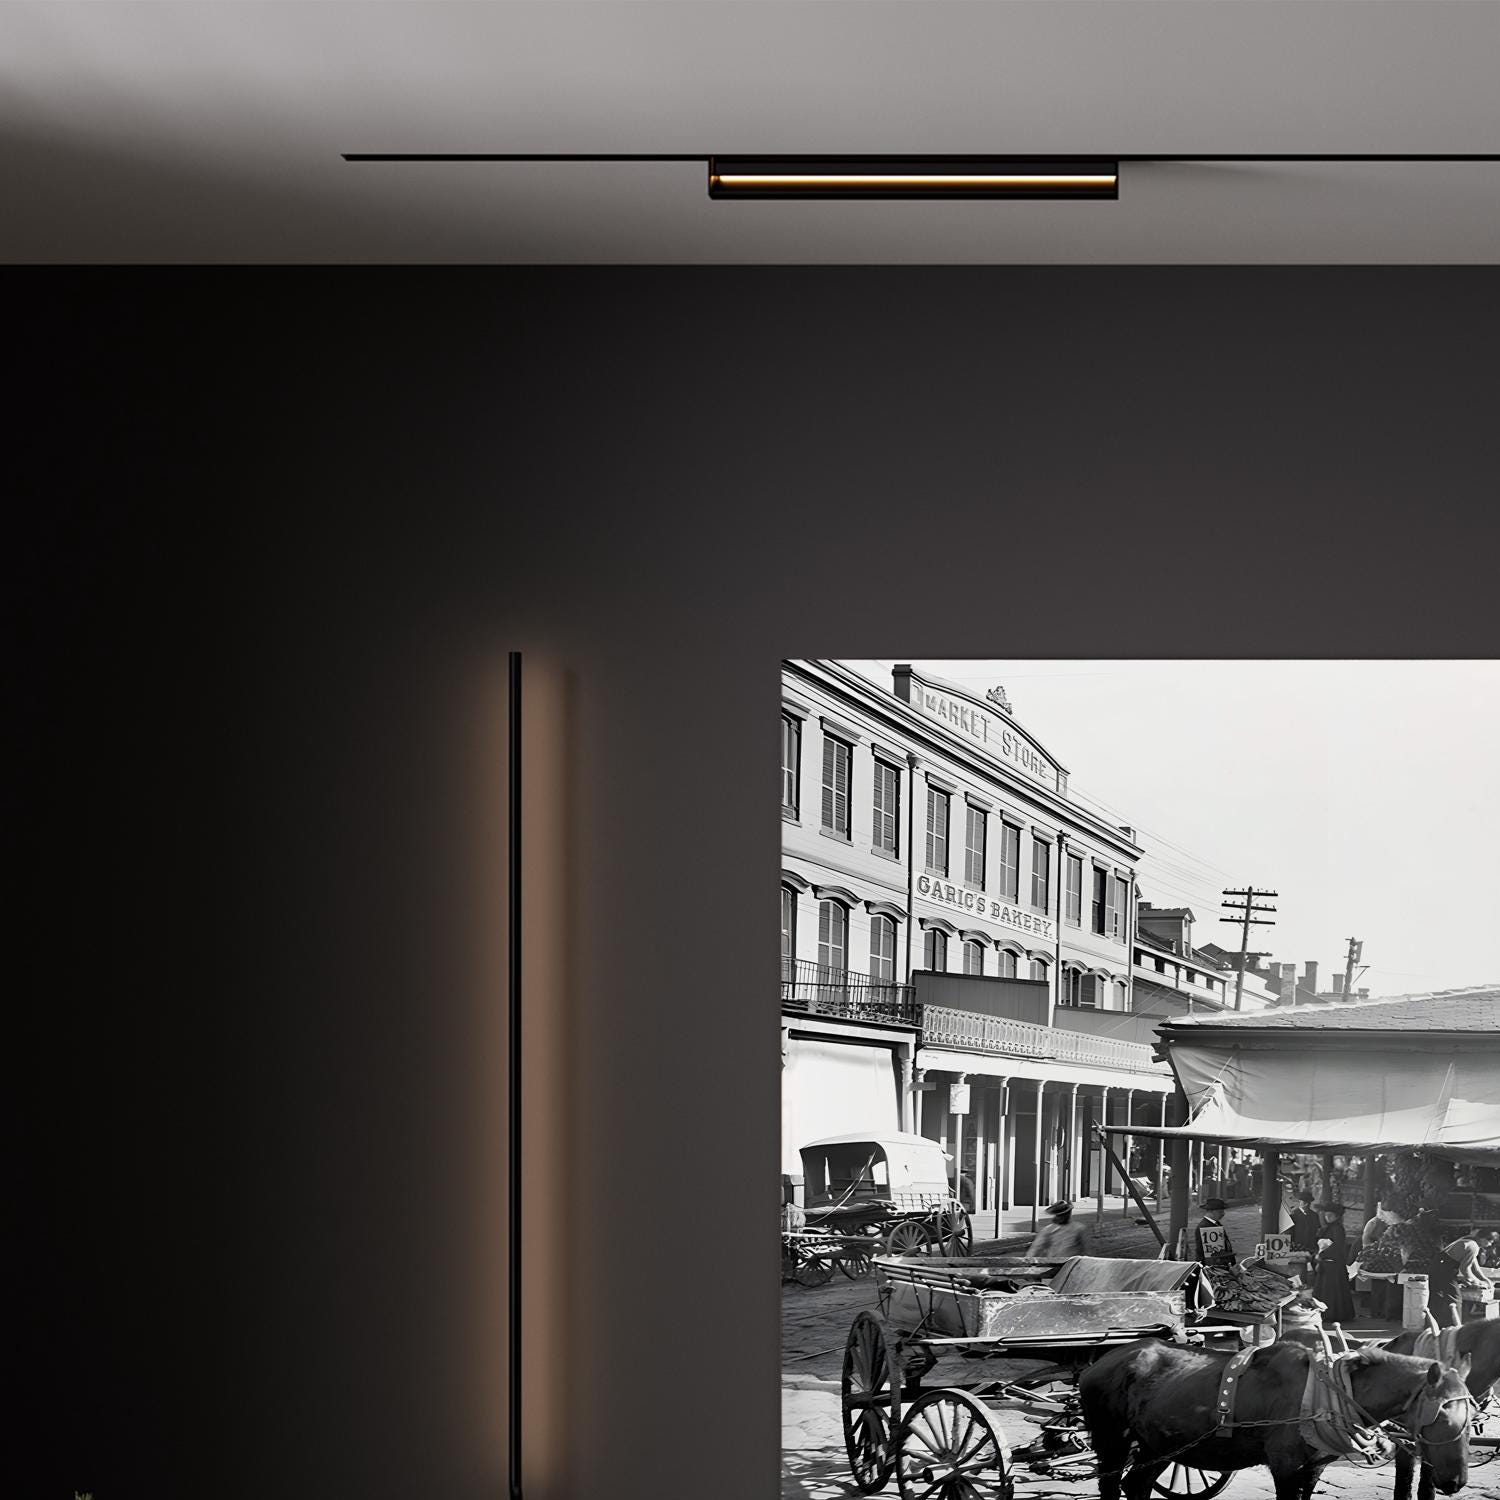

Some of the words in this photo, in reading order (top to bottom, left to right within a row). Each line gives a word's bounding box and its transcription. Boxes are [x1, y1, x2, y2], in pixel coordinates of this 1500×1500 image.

[925, 693, 991, 743] MARKET
[1001, 729, 1047, 779] STORE
[916, 875, 986, 915] GARIC'S
